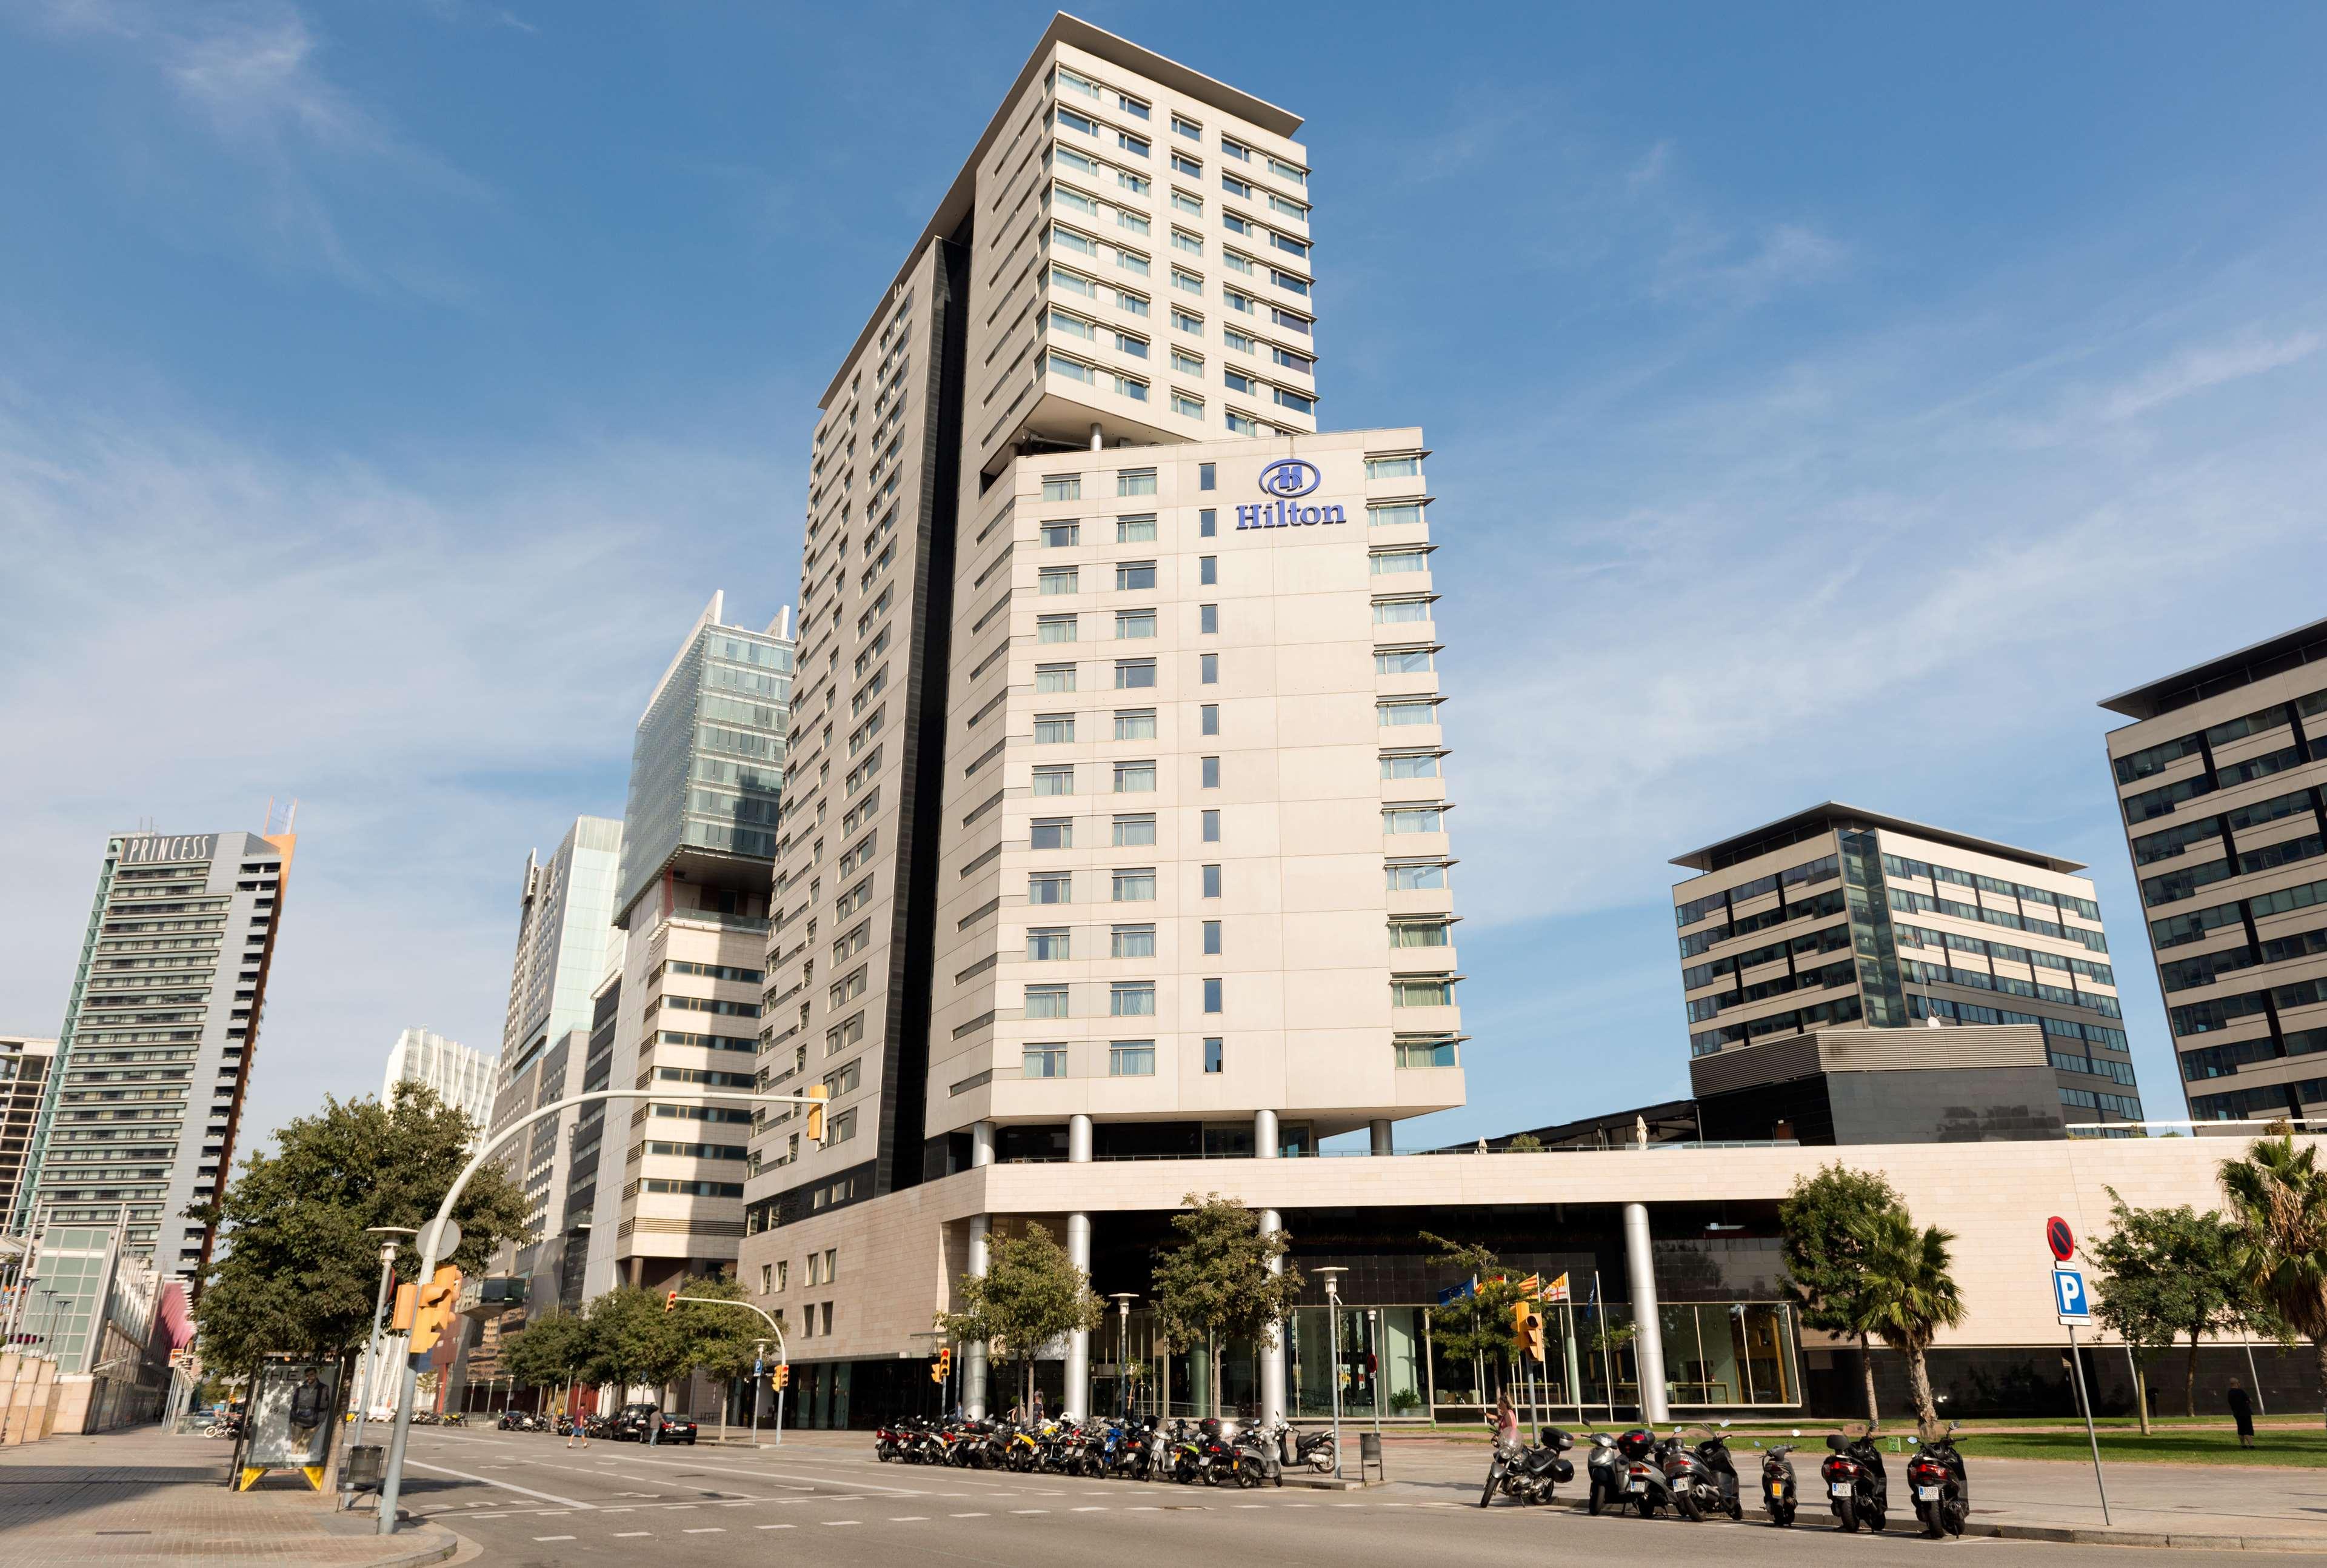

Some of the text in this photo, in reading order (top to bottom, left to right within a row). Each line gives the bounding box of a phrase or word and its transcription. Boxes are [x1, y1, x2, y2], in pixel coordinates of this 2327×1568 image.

[1236, 499, 1347, 530] Hilton
[129, 836, 209, 862] PRINCESS
[2060, 1275, 2080, 1310] P
